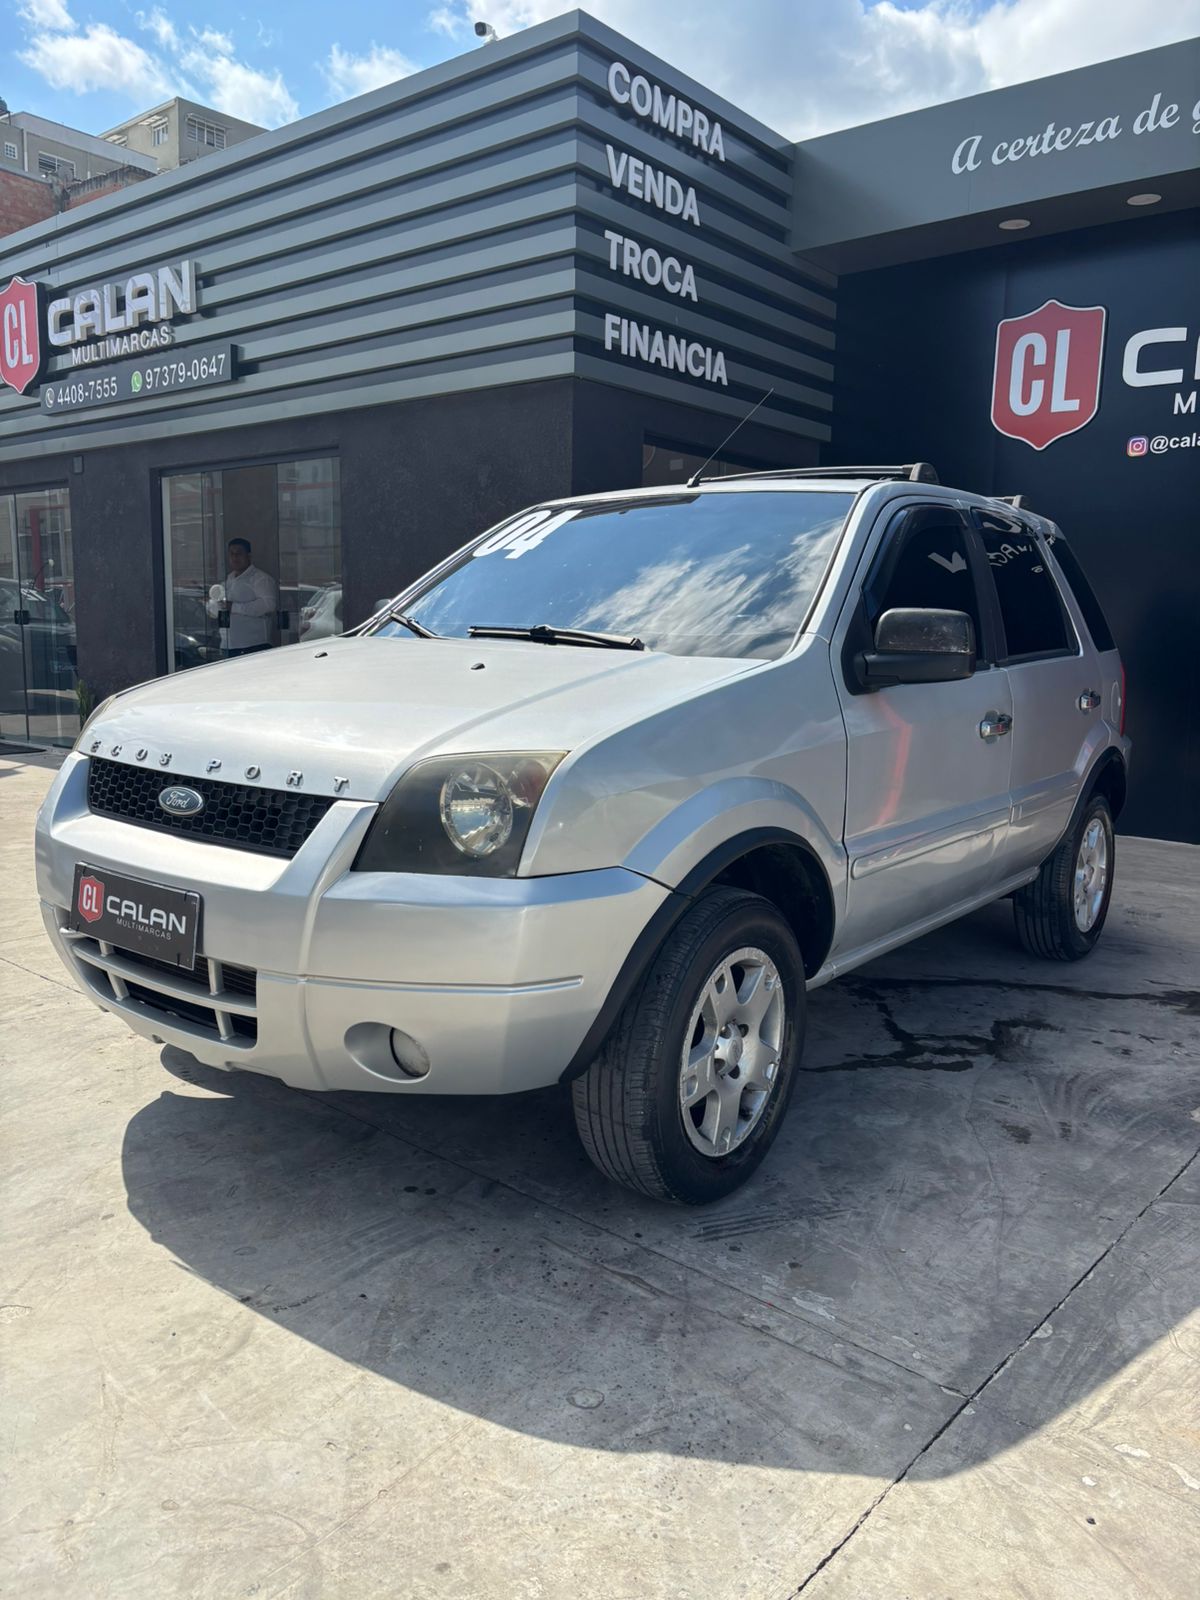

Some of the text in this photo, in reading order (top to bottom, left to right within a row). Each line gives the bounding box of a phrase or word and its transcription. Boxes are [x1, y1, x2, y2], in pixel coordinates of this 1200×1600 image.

[608, 61, 726, 162] COMPRA
[951, 135, 983, 175] A
[991, 115, 1123, 166] certeza
[1132, 92, 1181, 136] de
[605, 144, 701, 226] VENDA
[604, 229, 698, 302] TROCA
[3, 300, 33, 369] CL
[47, 259, 197, 347] CALAN
[71, 325, 171, 366] MULTIMARCAS
[604, 313, 729, 386] FINANCIA
[1009, 329, 1080, 416] CL
[1122, 327, 1200, 387] C
[57, 353, 226, 406] 4408-7555 97379-0647
[472, 509, 583, 559] 04
[166, 790, 191, 808] Ford
[82, 884, 99, 913] CL
[106, 895, 187, 935] CALAN
[116, 917, 172, 941] MULTIMARCAS
